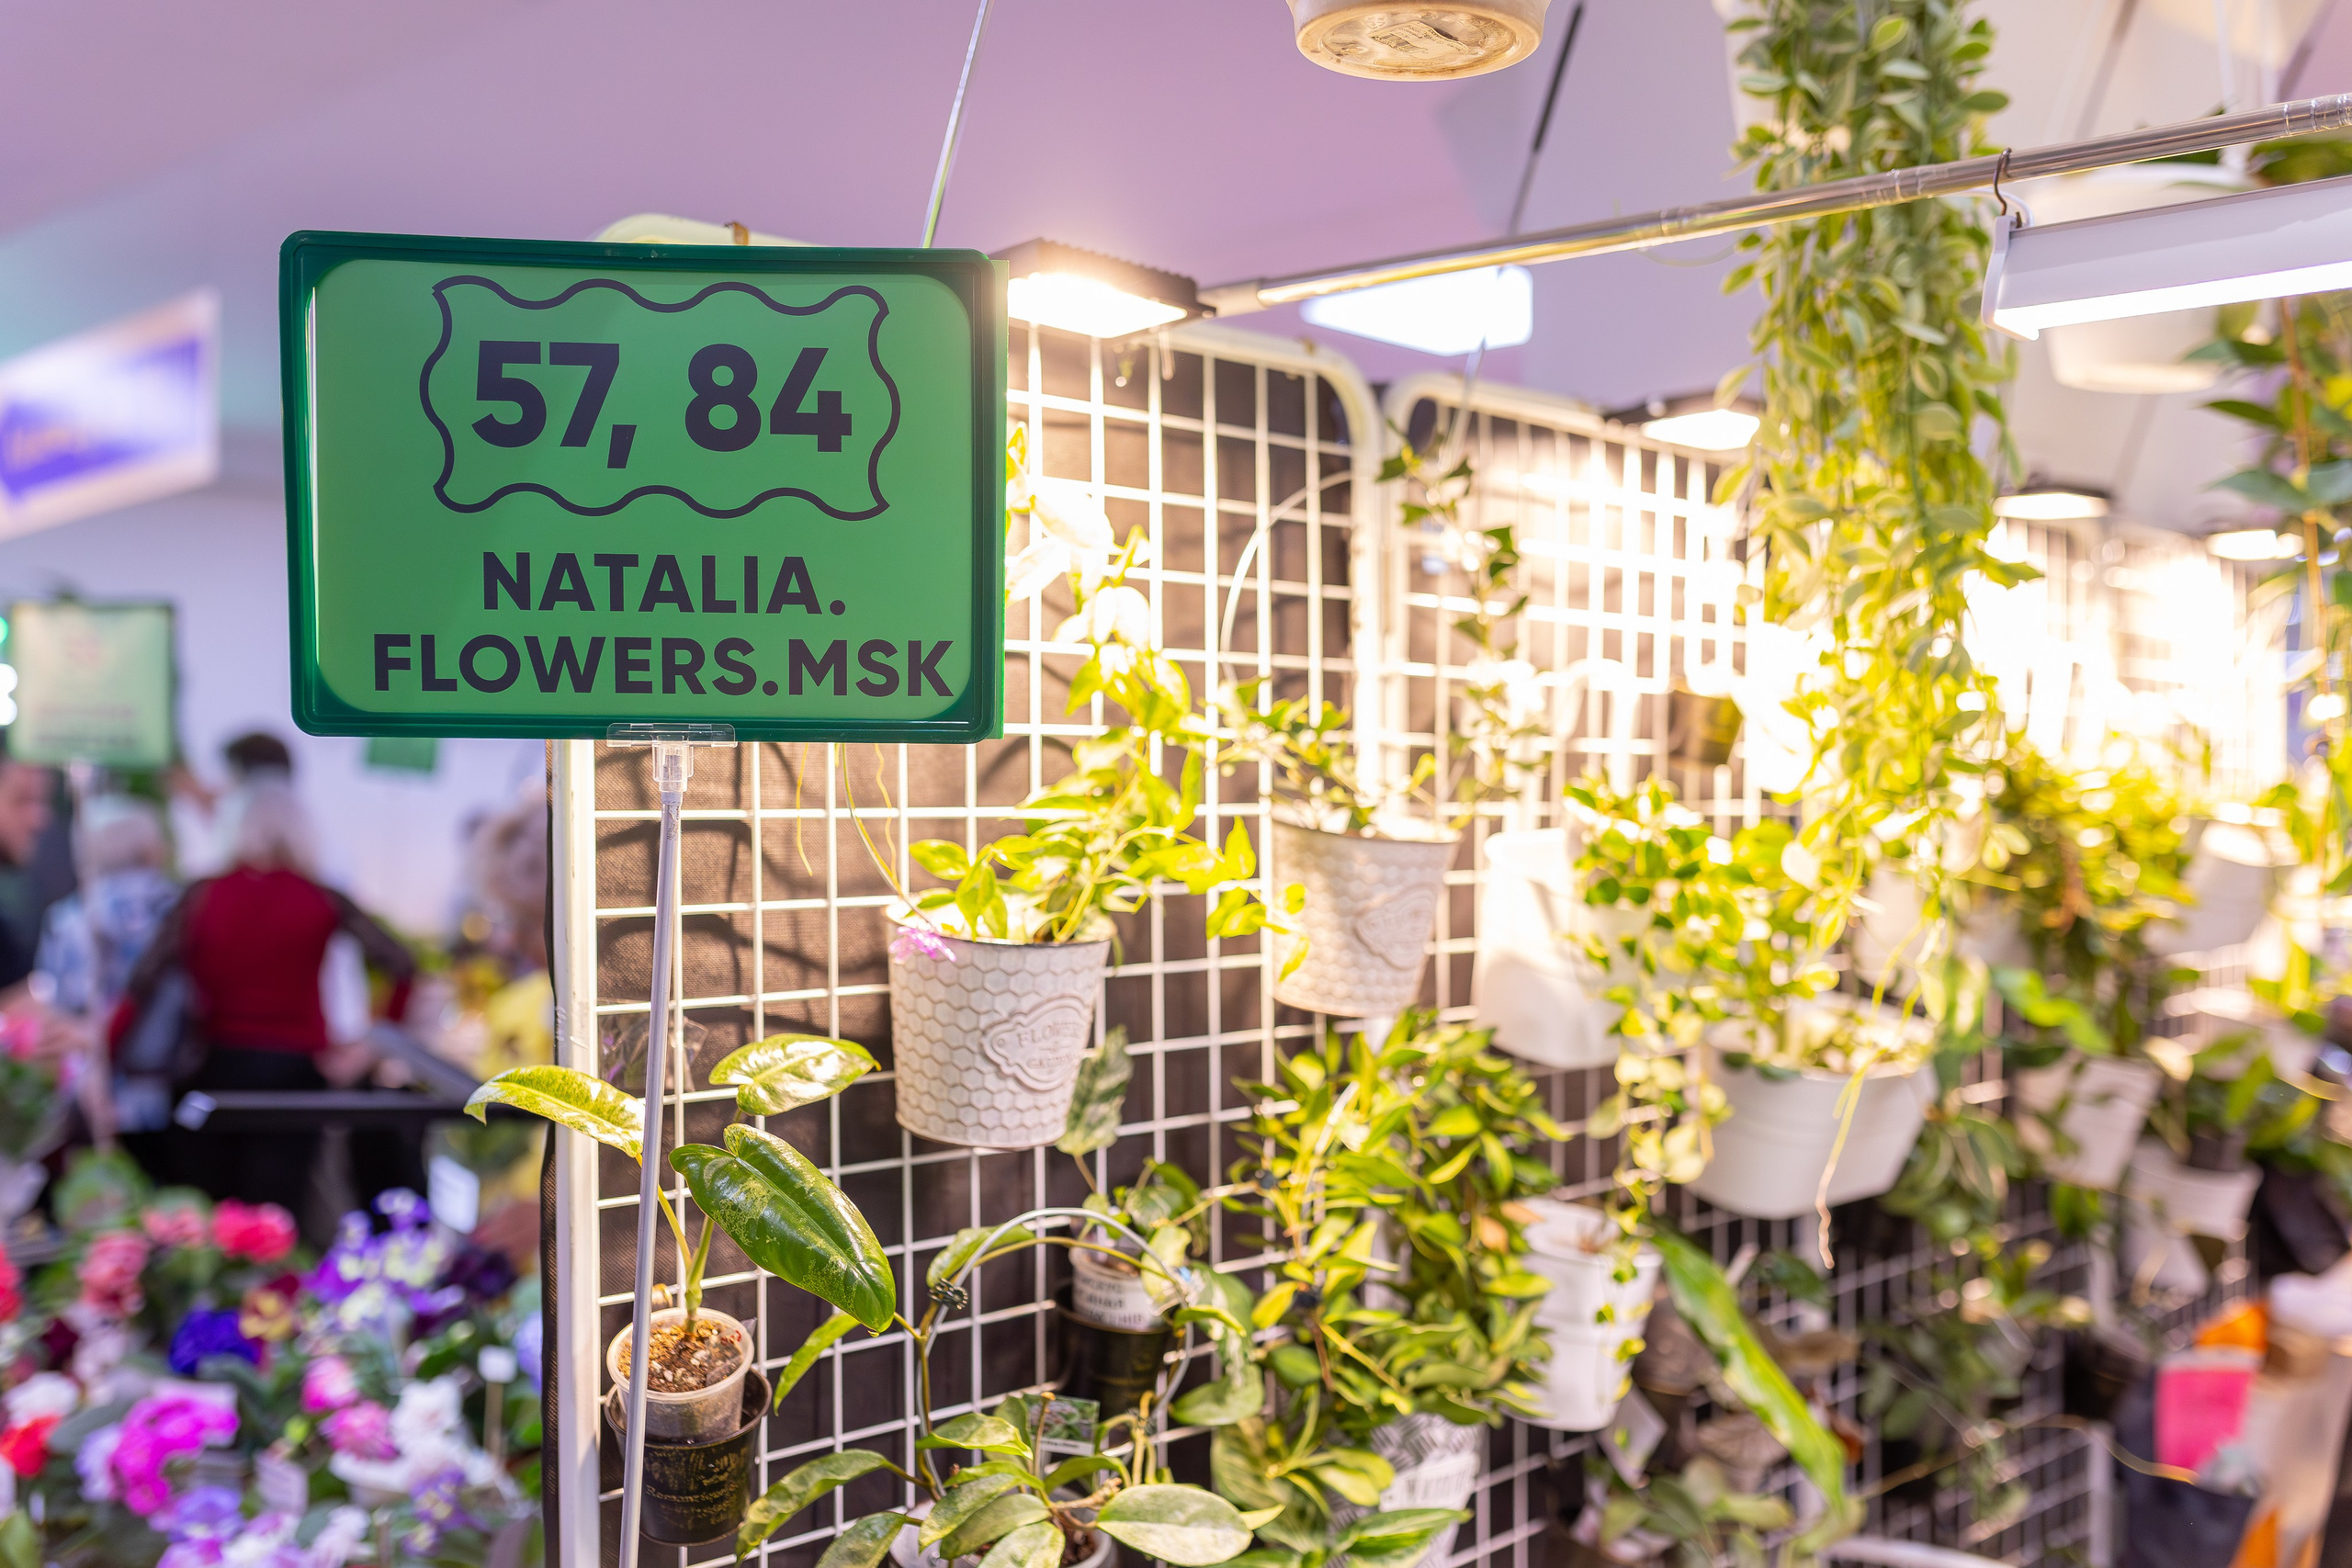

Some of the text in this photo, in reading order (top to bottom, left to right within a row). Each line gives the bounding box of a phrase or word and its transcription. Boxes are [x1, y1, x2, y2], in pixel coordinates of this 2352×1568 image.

[470, 339, 853, 469] 57, 84
[482, 551, 846, 616] NATALIA.
[373, 633, 955, 697] FLOWERS.MSK
